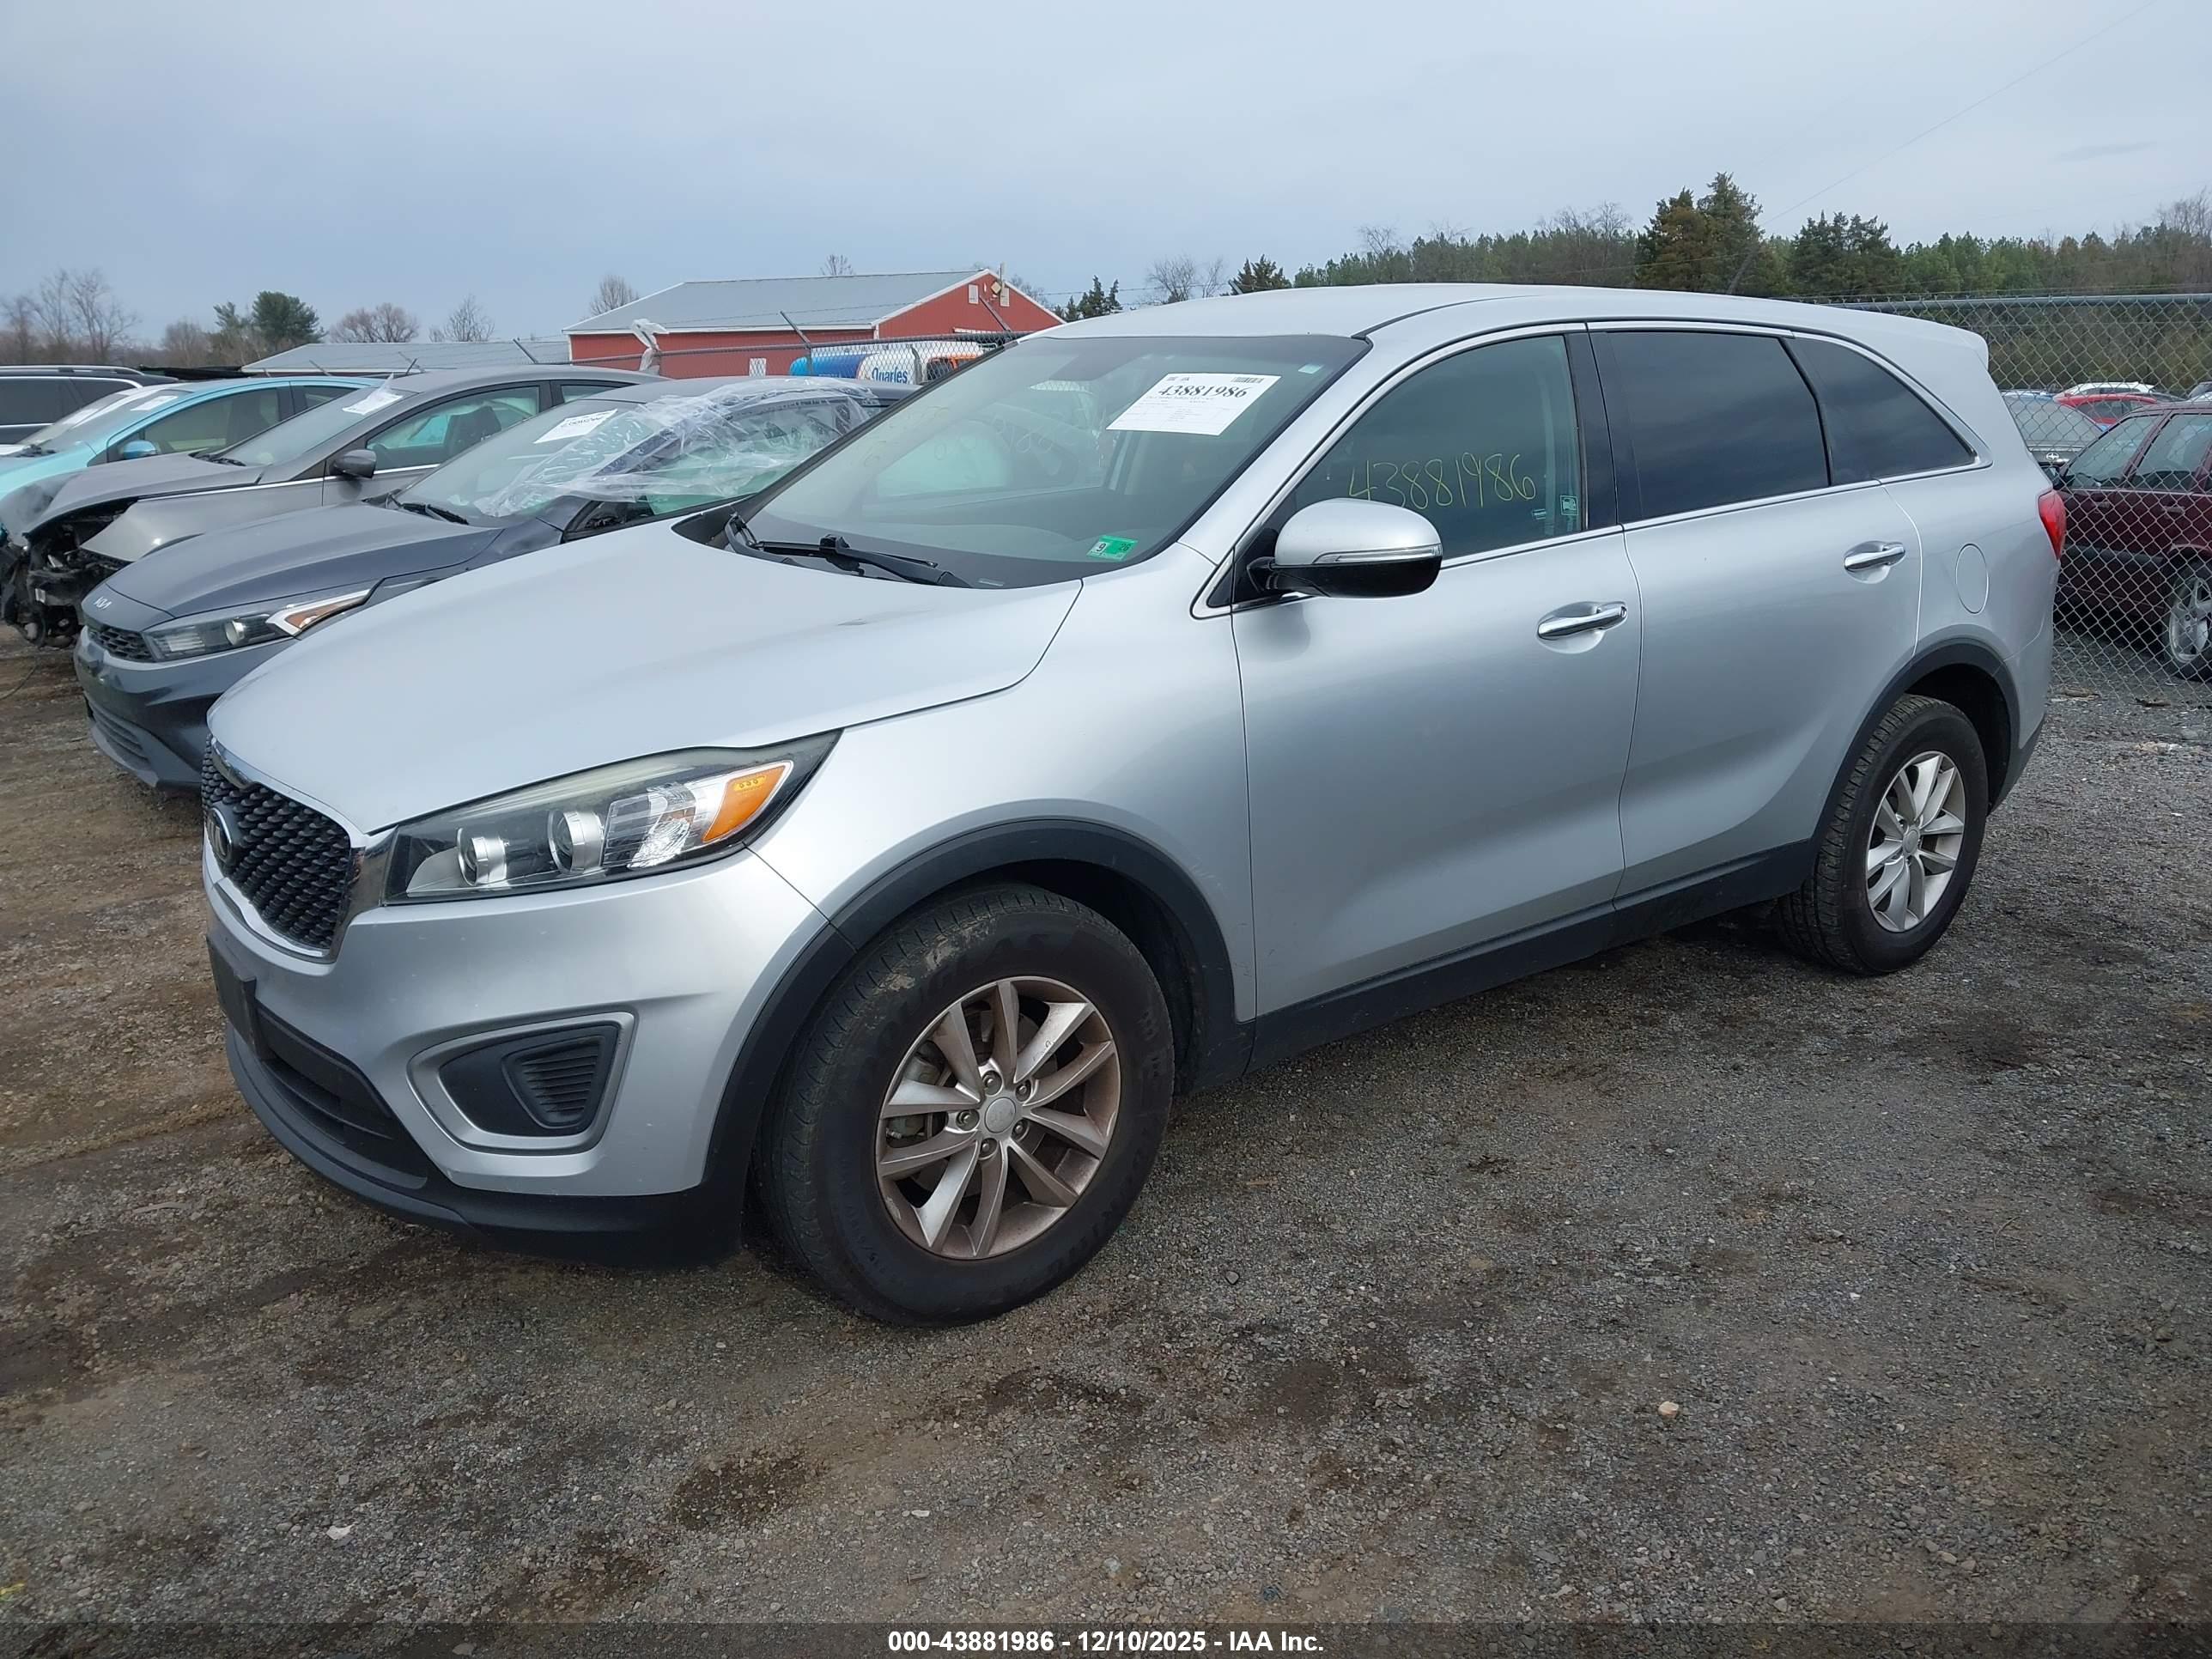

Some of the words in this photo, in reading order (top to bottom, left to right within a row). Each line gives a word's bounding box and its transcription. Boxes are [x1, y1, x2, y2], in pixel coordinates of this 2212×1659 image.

[872, 367, 908, 383] Quarles
[1158, 385, 1251, 398] 43881986
[1349, 453, 1536, 509] 43881986
[1097, 543, 1106, 551] 9
